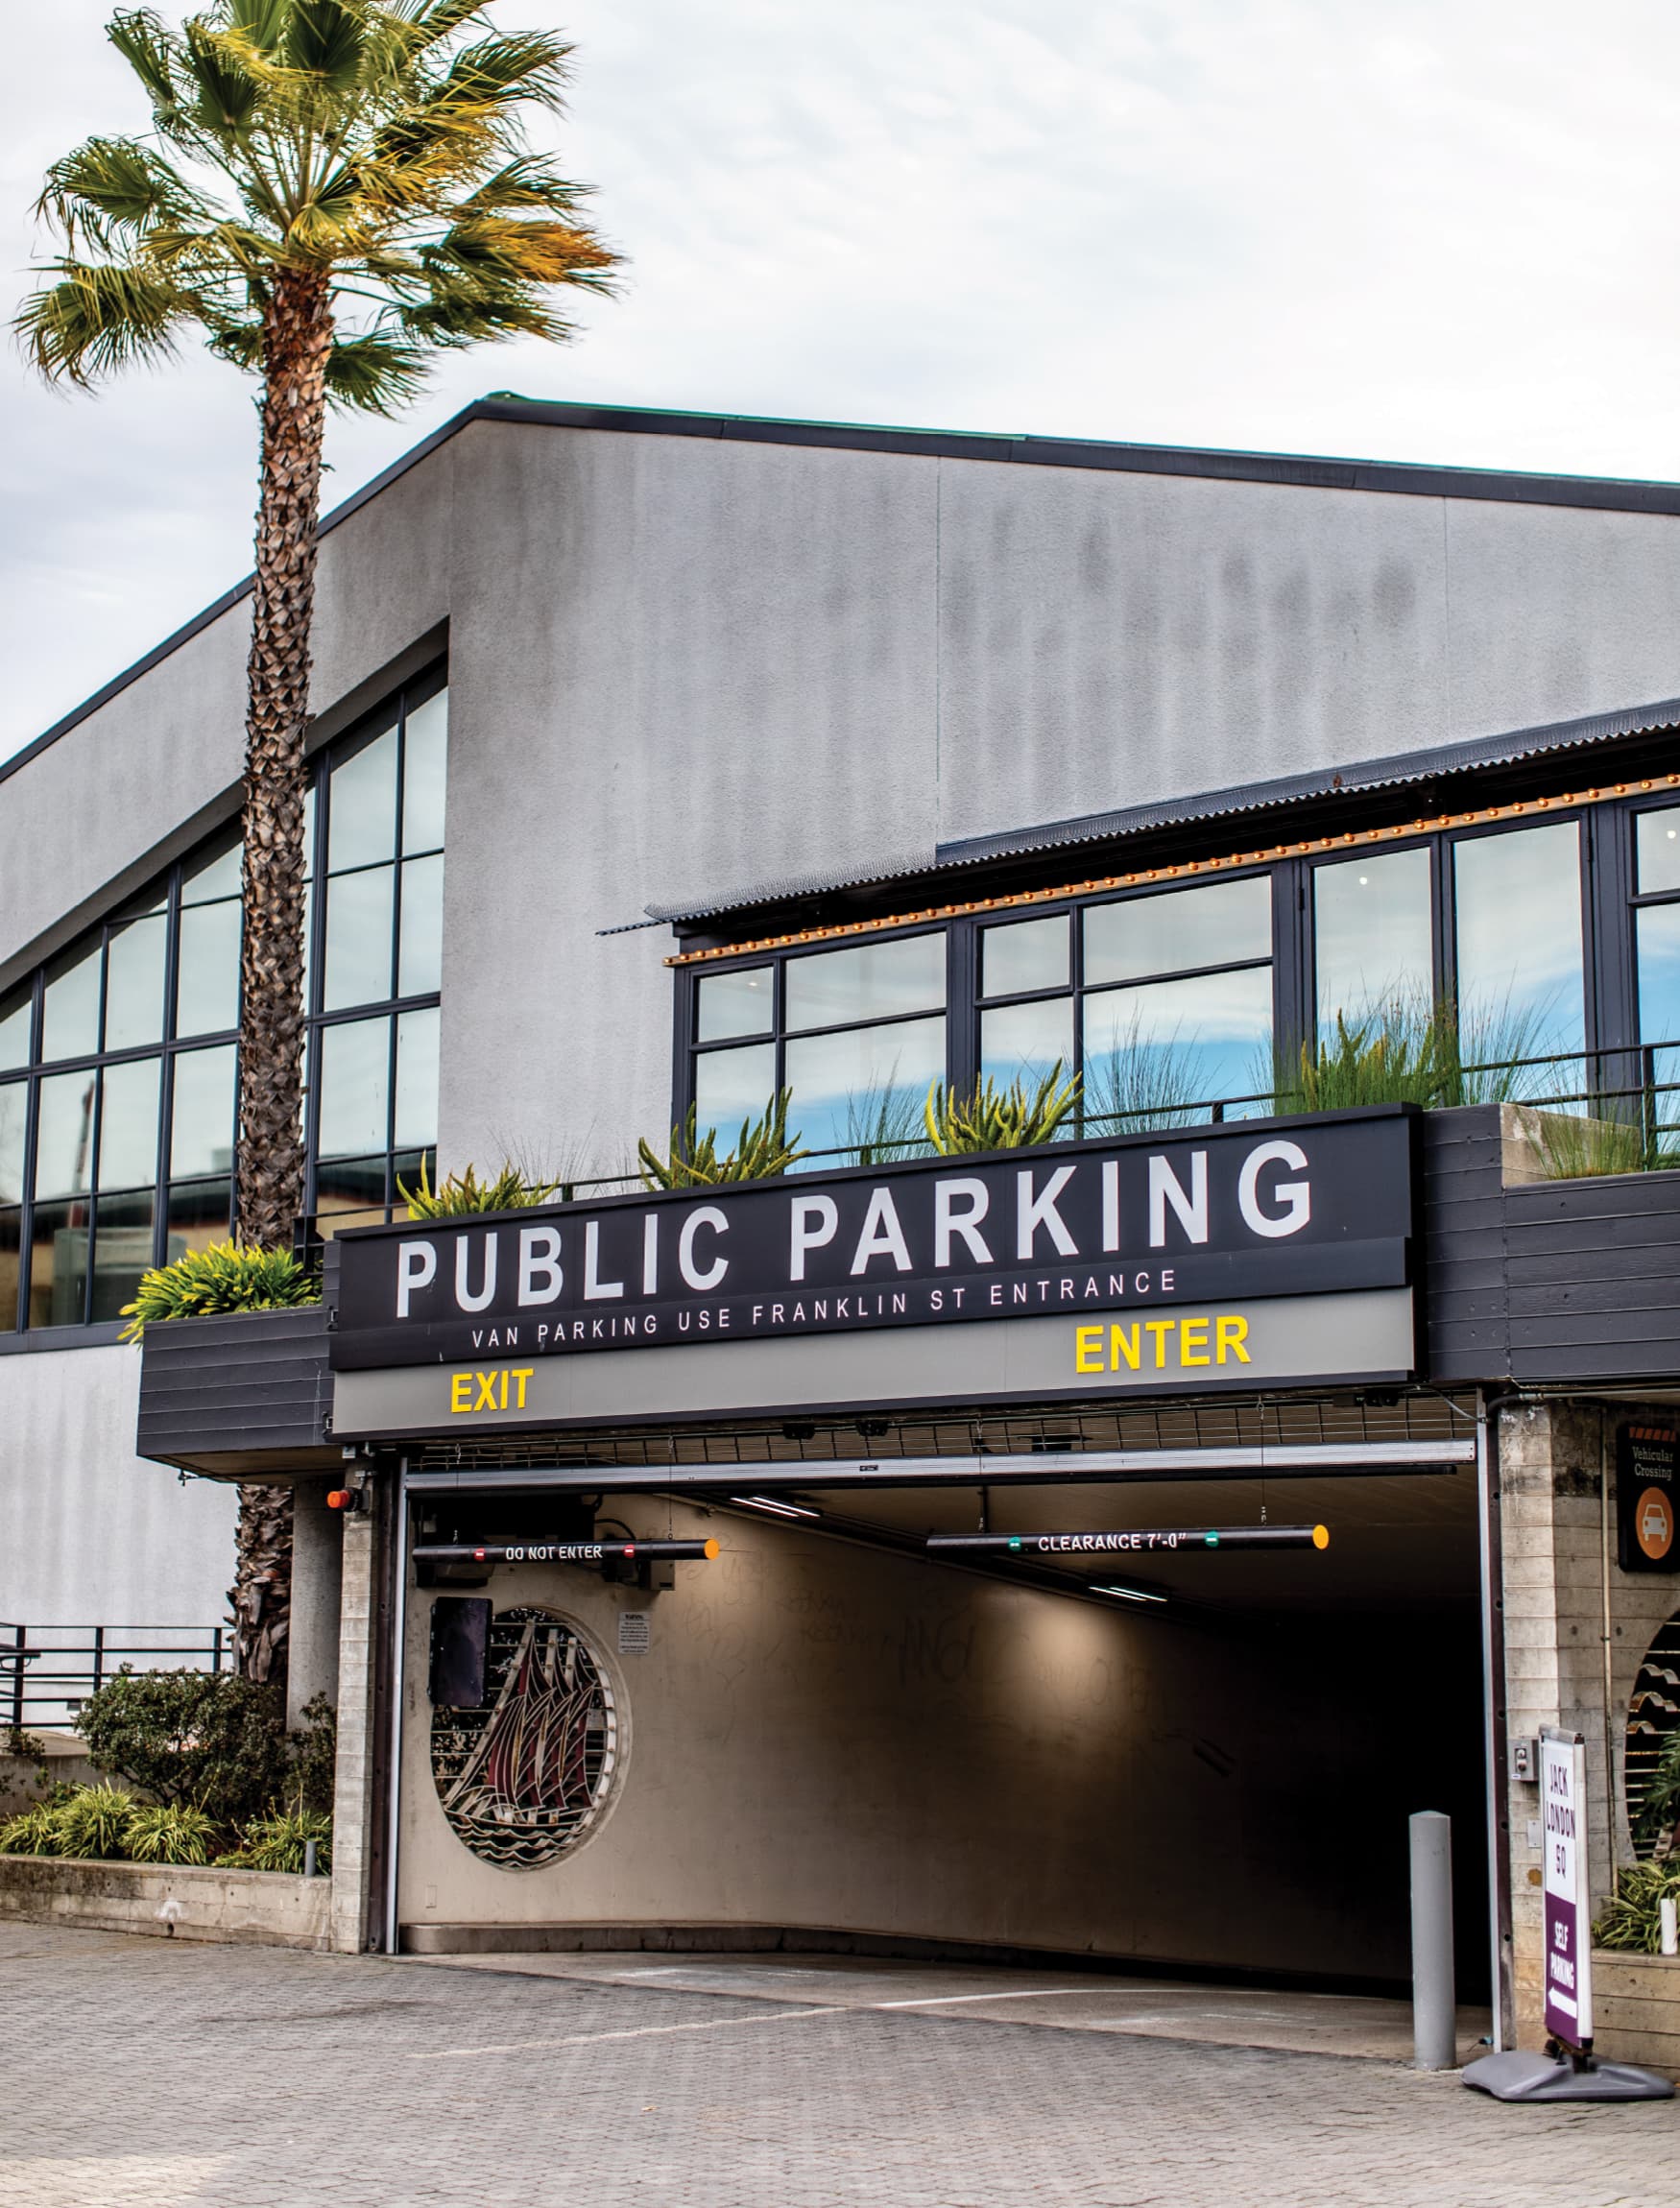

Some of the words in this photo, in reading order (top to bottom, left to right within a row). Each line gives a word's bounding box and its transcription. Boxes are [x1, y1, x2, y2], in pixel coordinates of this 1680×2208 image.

[396, 1206, 729, 1318] PUBLIC
[790, 1140, 1310, 1282] PARKING
[472, 1327, 518, 1348] VAN
[538, 1314, 657, 1343] PARKING
[679, 1308, 731, 1332] USE
[753, 1293, 906, 1326] FRANKLIN
[930, 1288, 965, 1311] ST
[991, 1269, 1175, 1306] ENTRANCE
[1075, 1315, 1252, 1374] ENTER
[450, 1368, 534, 1413] EXIT
[1632, 1446, 1674, 1462] Vehicular
[1634, 1463, 1672, 1481] Crossing
[505, 1547, 524, 1560] DO
[528, 1547, 556, 1560] NOT
[559, 1545, 603, 1559] ENTER
[1038, 1534, 1142, 1551] CLEARANCE
[1549, 1764, 1569, 1797] JACK
[1547, 1800, 1575, 1840] LONDON
[1555, 1844, 1567, 1879] SQ
[1554, 1920, 1569, 1952] SELF
